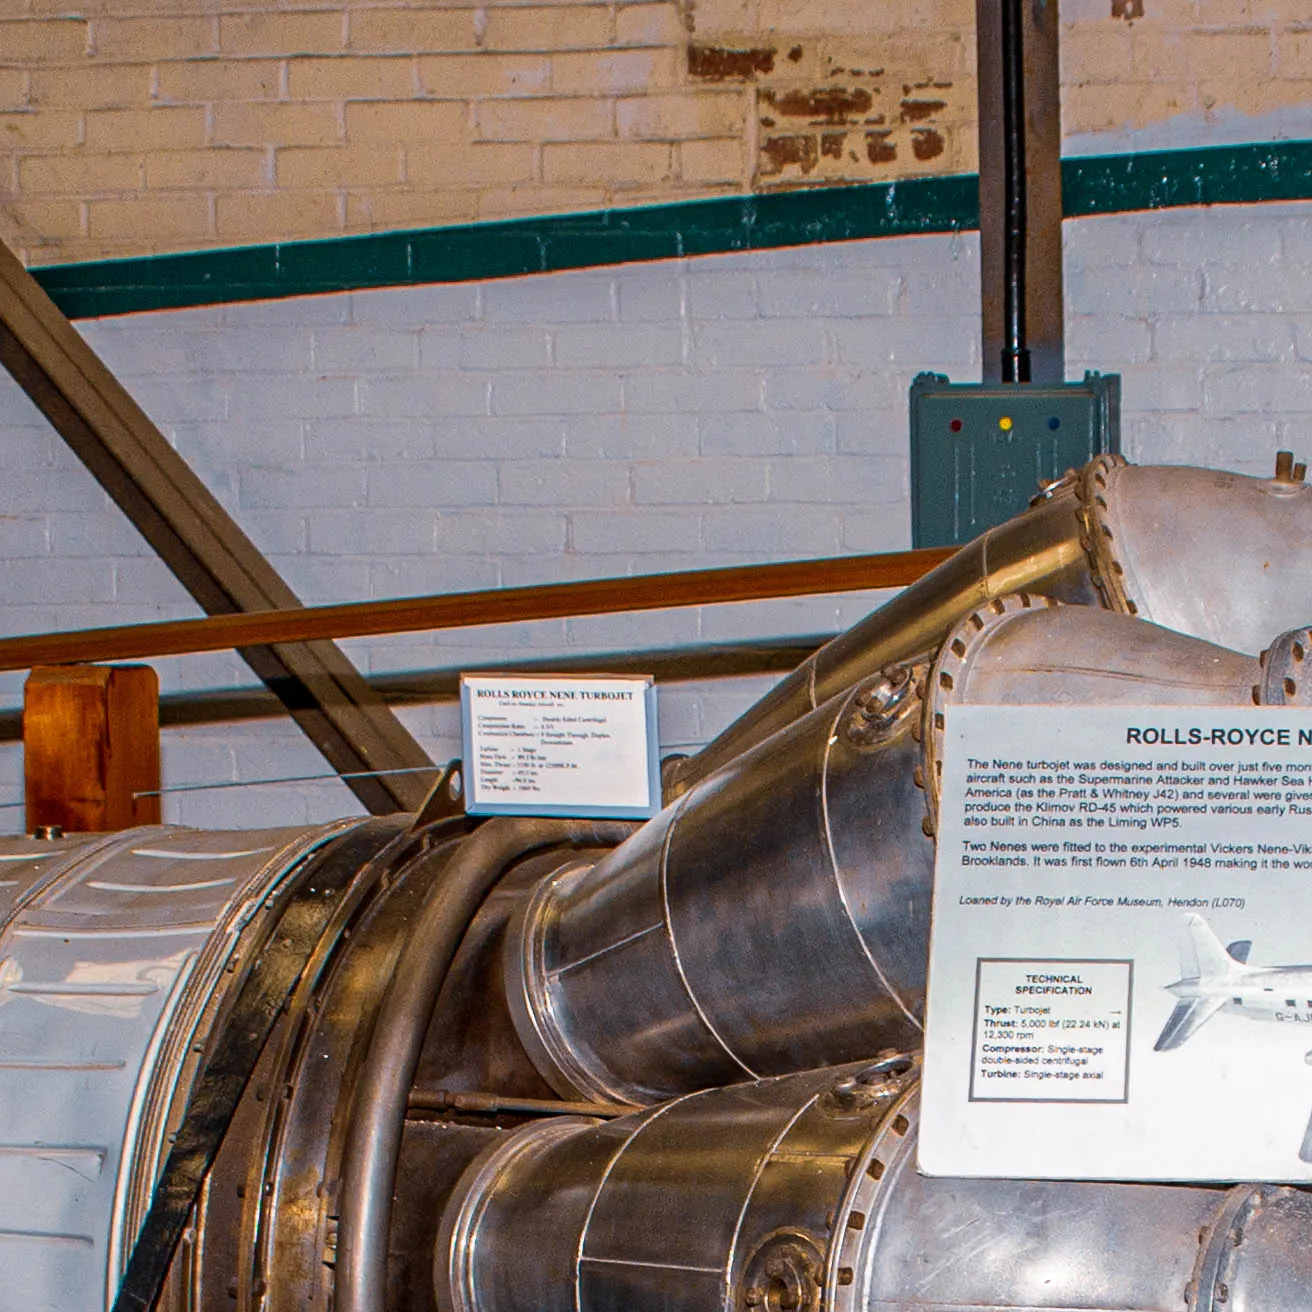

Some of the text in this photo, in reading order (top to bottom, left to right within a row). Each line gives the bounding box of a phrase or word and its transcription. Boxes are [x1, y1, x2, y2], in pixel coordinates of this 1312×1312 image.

[477, 689, 634, 702] ROLLS ROYCE NENE TURBOJET
[1126, 727, 1291, 745] ROLLS-ROYCE
[967, 758, 989, 769] The
[992, 759, 1024, 769] Nene
[1026, 759, 1070, 772] turbojet
[1072, 761, 1096, 770] was
[1099, 760, 1153, 773] designed
[1155, 760, 1178, 771] and
[1180, 761, 1206, 771] built
[1208, 762, 1235, 771] over
[1236, 762, 1259, 773] just
[1261, 761, 1283, 771] five
[965, 772, 1006, 783] aircraft
[1008, 773, 1036, 783] such
[1039, 775, 1053, 783] as
[1056, 773, 1075, 784] the
[1077, 773, 1153, 786] Supermarine
[1155, 774, 1205, 785] Attacker
[1207, 775, 1230, 785] and
[1233, 775, 1279, 785] Hawker
[1280, 775, 1305, 785] Sea
[964, 786, 1013, 798] America
[1015, 788, 1034, 799] (as
[1036, 787, 1056, 798] the
[1058, 787, 1087, 798] Pratt
[1089, 787, 1099, 798] &
[1101, 788, 1150, 801] Whitney
[1152, 788, 1179, 801] J42)
[1181, 789, 1204, 799] and
[1207, 789, 1250, 800] several
[1252, 791, 1282, 800] were
[964, 800, 1011, 813] produce
[1013, 801, 1033, 812] the
[1034, 801, 1075, 812] Klimov
[1078, 801, 1117, 813] RD-45
[1119, 802, 1154, 813] which
[1156, 803, 1208, 815] powered
[1210, 805, 1253, 814] various
[1256, 804, 1286, 816] early
[963, 815, 1182, 829] also built in China as the Liming WP5.
[961, 840, 987, 851] Two
[989, 840, 1027, 851] Nenes
[1030, 842, 1060, 852] were
[1062, 840, 1092, 852] fitted
[1094, 842, 1106, 852] to
[1108, 842, 1128, 852] the
[1130, 842, 1207, 854] experimental
[1209, 843, 1254, 854] Vickers
[961, 854, 1029, 866] Brooklands.
[1033, 855, 1041, 866] It
[1043, 857, 1068, 866] was
[1070, 855, 1093, 866] first
[1095, 855, 1127, 867] flown
[1129, 856, 1148, 867] 6th
[1151, 856, 1179, 869] April
[1183, 857, 1212, 868] 1948
[1214, 857, 1258, 871] making
[1260, 859, 1268, 868] it
[1271, 858, 1290, 868] the
[958, 895, 1245, 909] Loaned by the Royal Air Force Museum, Hendon (L070)
[1025, 974, 1083, 985] TECHNICAL
[1015, 985, 1093, 995] SPECIFICATION
[984, 1004, 1051, 1015] Type: Turbojet
[983, 1018, 1018, 1027] Thrust:
[1020, 1018, 1046, 1028] 5,000
[1015, 1032, 1034, 1040] rpm
[981, 1043, 1104, 1055] Compressor: Single-stage
[981, 1056, 1089, 1066] double-sided centrifugal
[980, 1068, 1021, 1078] Turbine:
[1023, 1069, 1080, 1081] Single-stage
